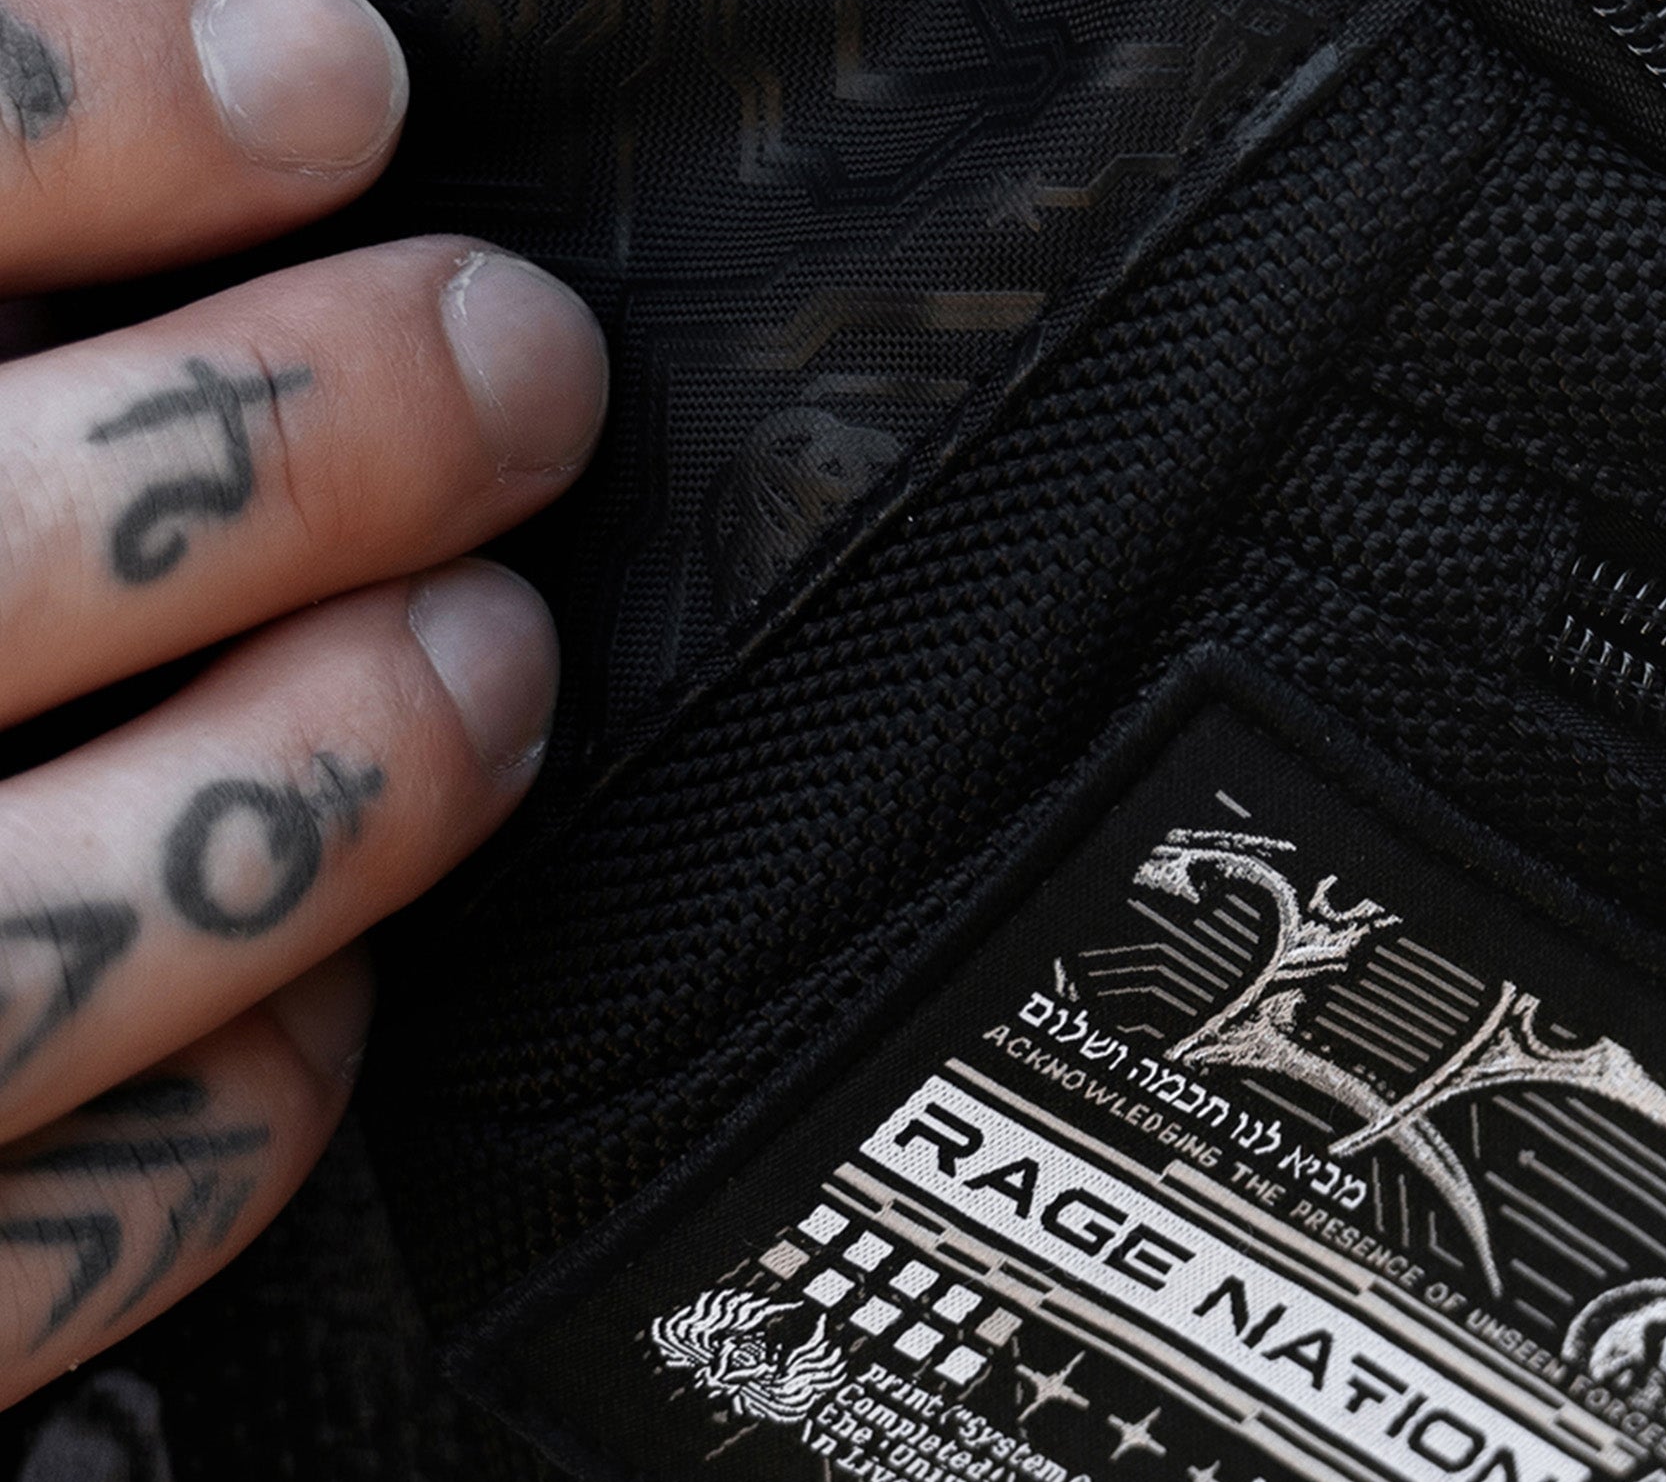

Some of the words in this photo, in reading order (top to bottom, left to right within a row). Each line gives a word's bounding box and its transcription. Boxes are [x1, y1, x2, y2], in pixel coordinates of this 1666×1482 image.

[1018, 992, 1129, 1070] ושלום
[1127, 1057, 1231, 1127] חכמה
[1230, 1111, 1282, 1155] לנו
[894, 1103, 1194, 1291] RAGE
[982, 1025, 1223, 1168] ACKNOWLEDGING
[1231, 1161, 1286, 1206] THE
[1290, 1200, 1425, 1287] PRESENCE
[1424, 1282, 1467, 1310] OF
[1465, 1308, 1567, 1382] UNSEEN
[1277, 1145, 1367, 1210] מביא
[816, 1402, 873, 1445] the
